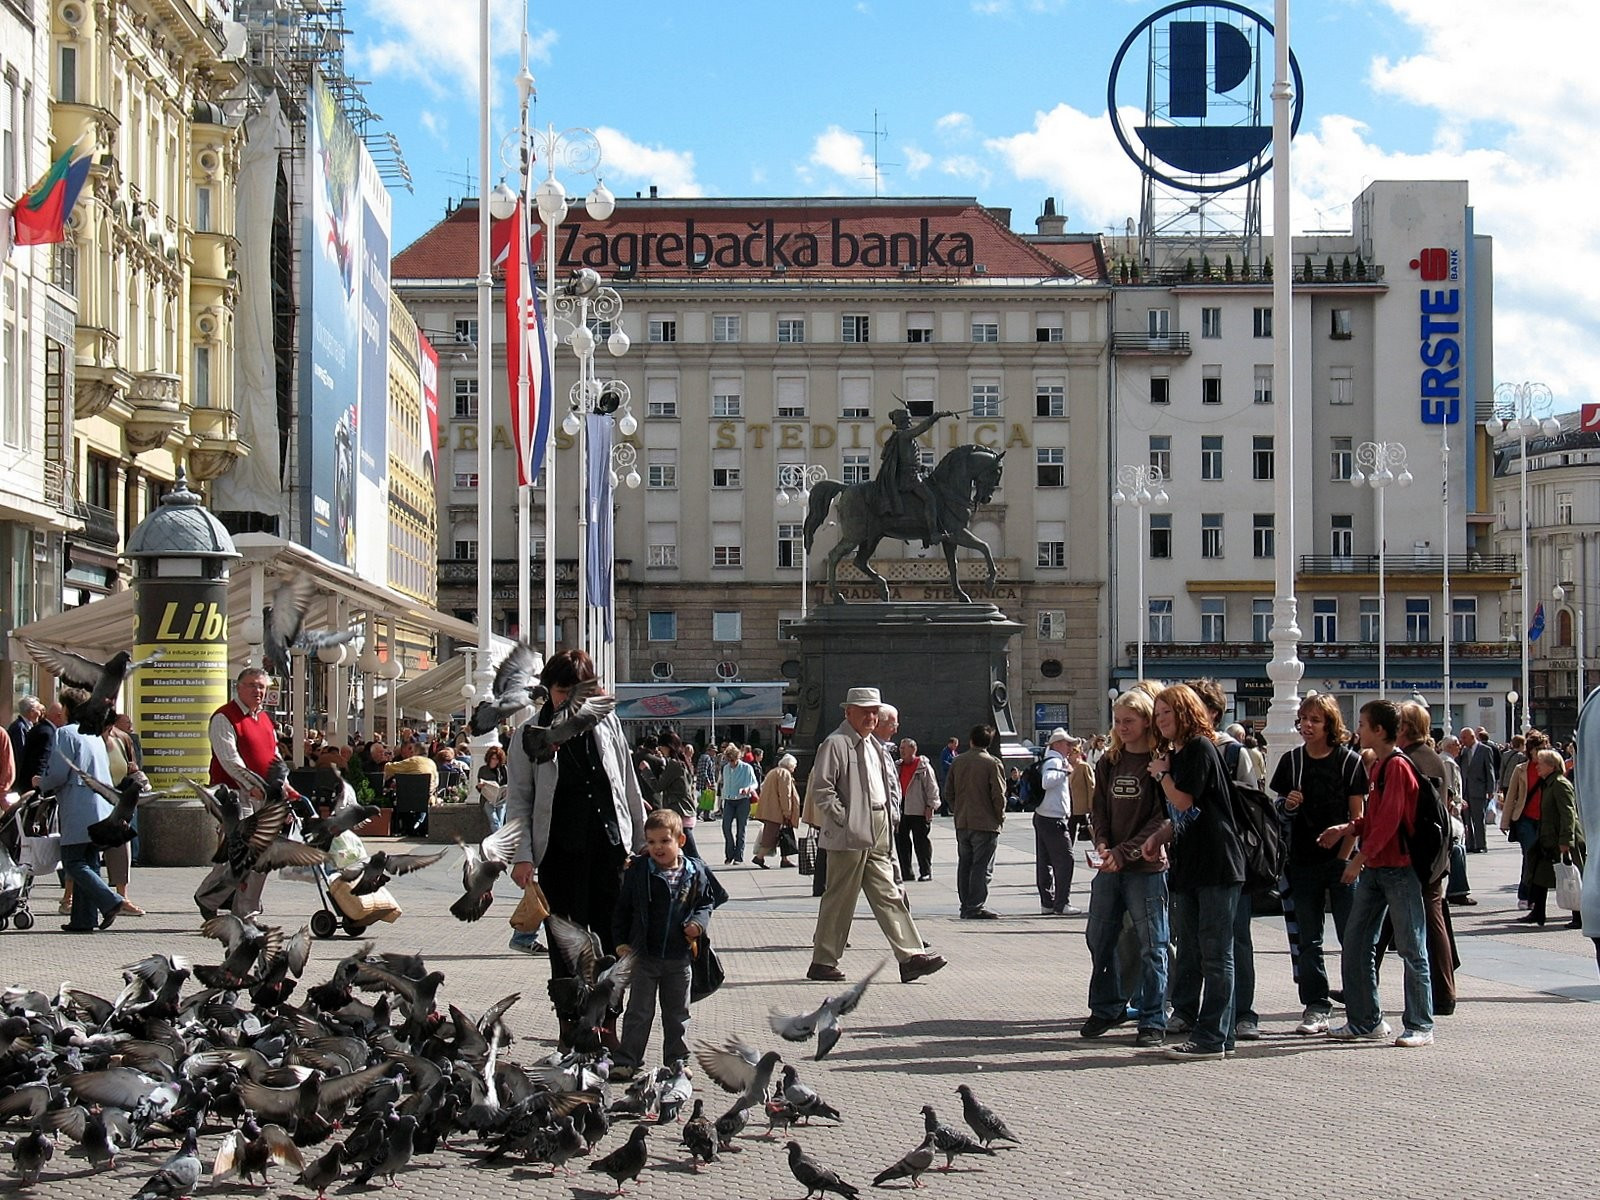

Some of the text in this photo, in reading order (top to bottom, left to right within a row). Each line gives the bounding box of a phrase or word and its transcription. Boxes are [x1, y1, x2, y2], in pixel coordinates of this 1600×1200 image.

[558, 218, 973, 279] Zagrebačka banka
[1449, 249, 1459, 281] BANK
[1420, 289, 1460, 424] ERSTE
[1338, 680, 1489, 689] Turističi informativi centar
[153, 750, 185, 758] Hip-Hop
